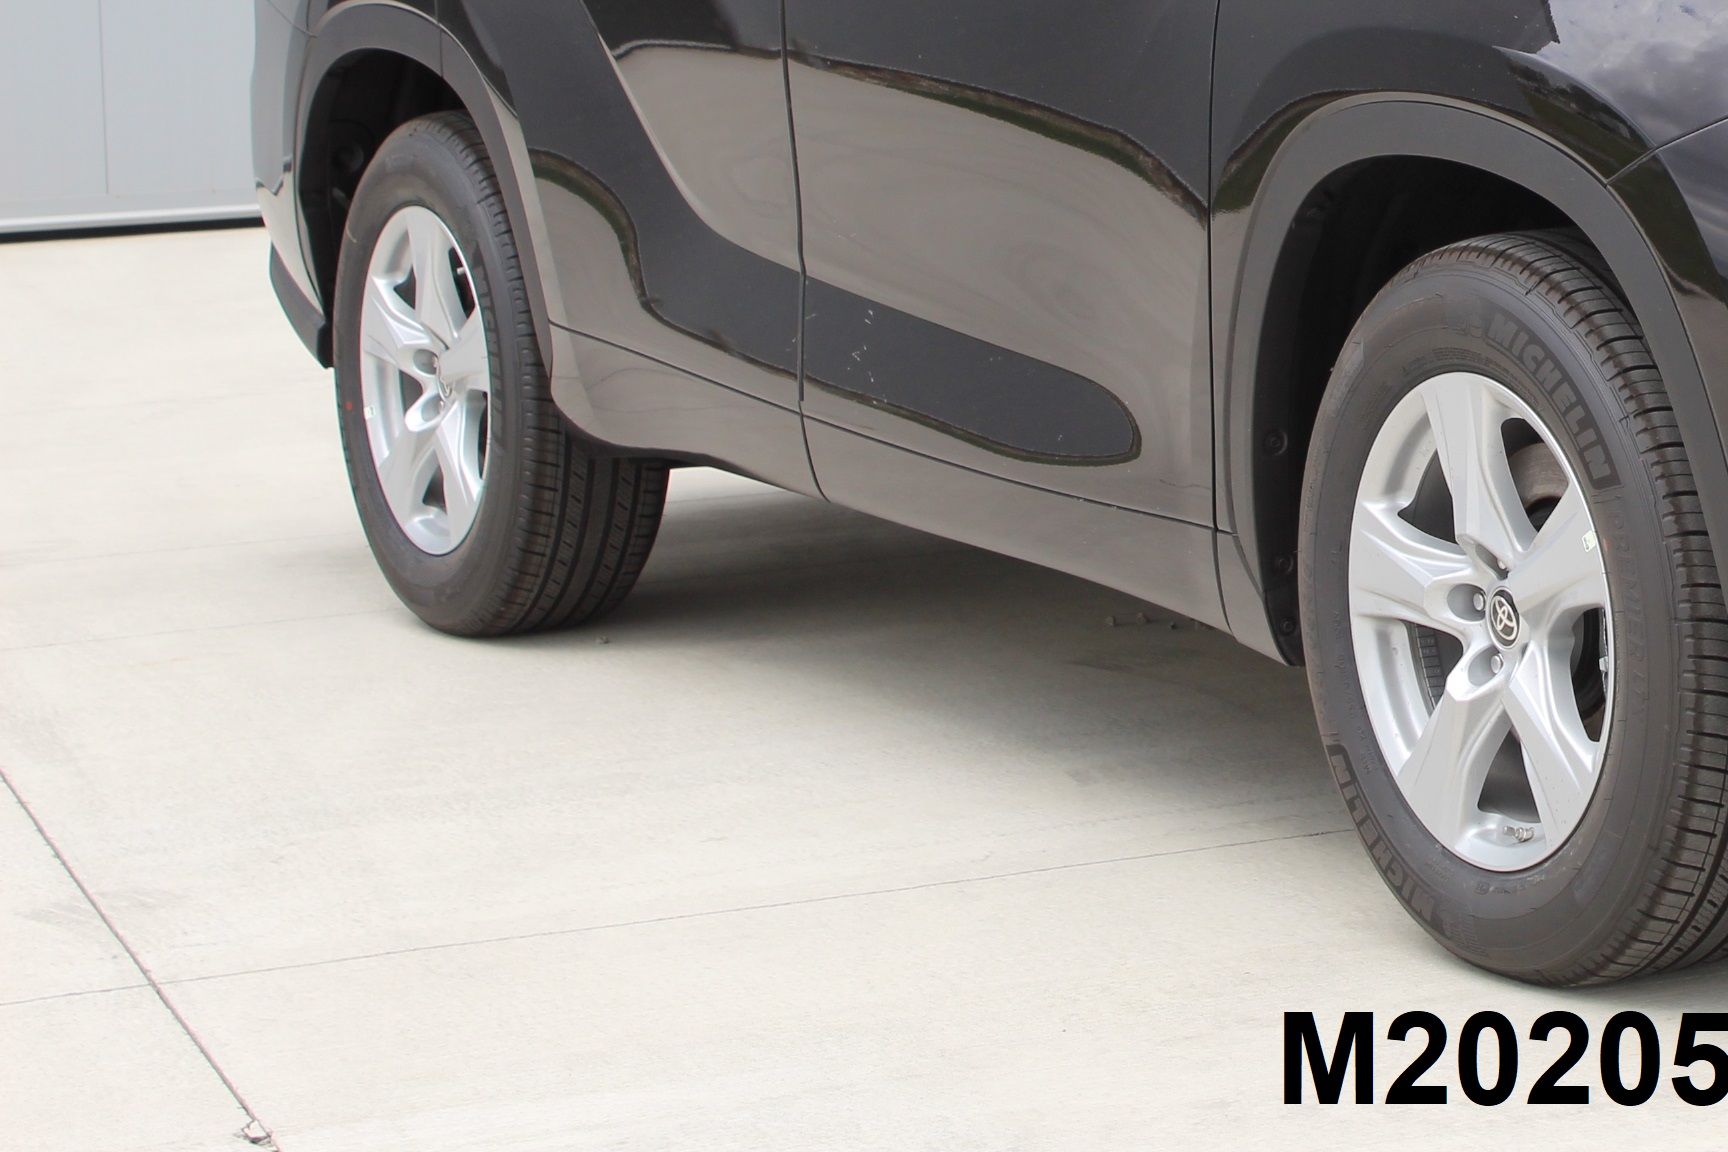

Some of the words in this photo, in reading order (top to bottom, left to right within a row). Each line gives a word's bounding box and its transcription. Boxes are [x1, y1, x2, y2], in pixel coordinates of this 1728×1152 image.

[472, 265, 503, 443] MICHELIN
[1487, 312, 1612, 481] MICHELIN
[1331, 754, 1437, 923] MICHELIN
